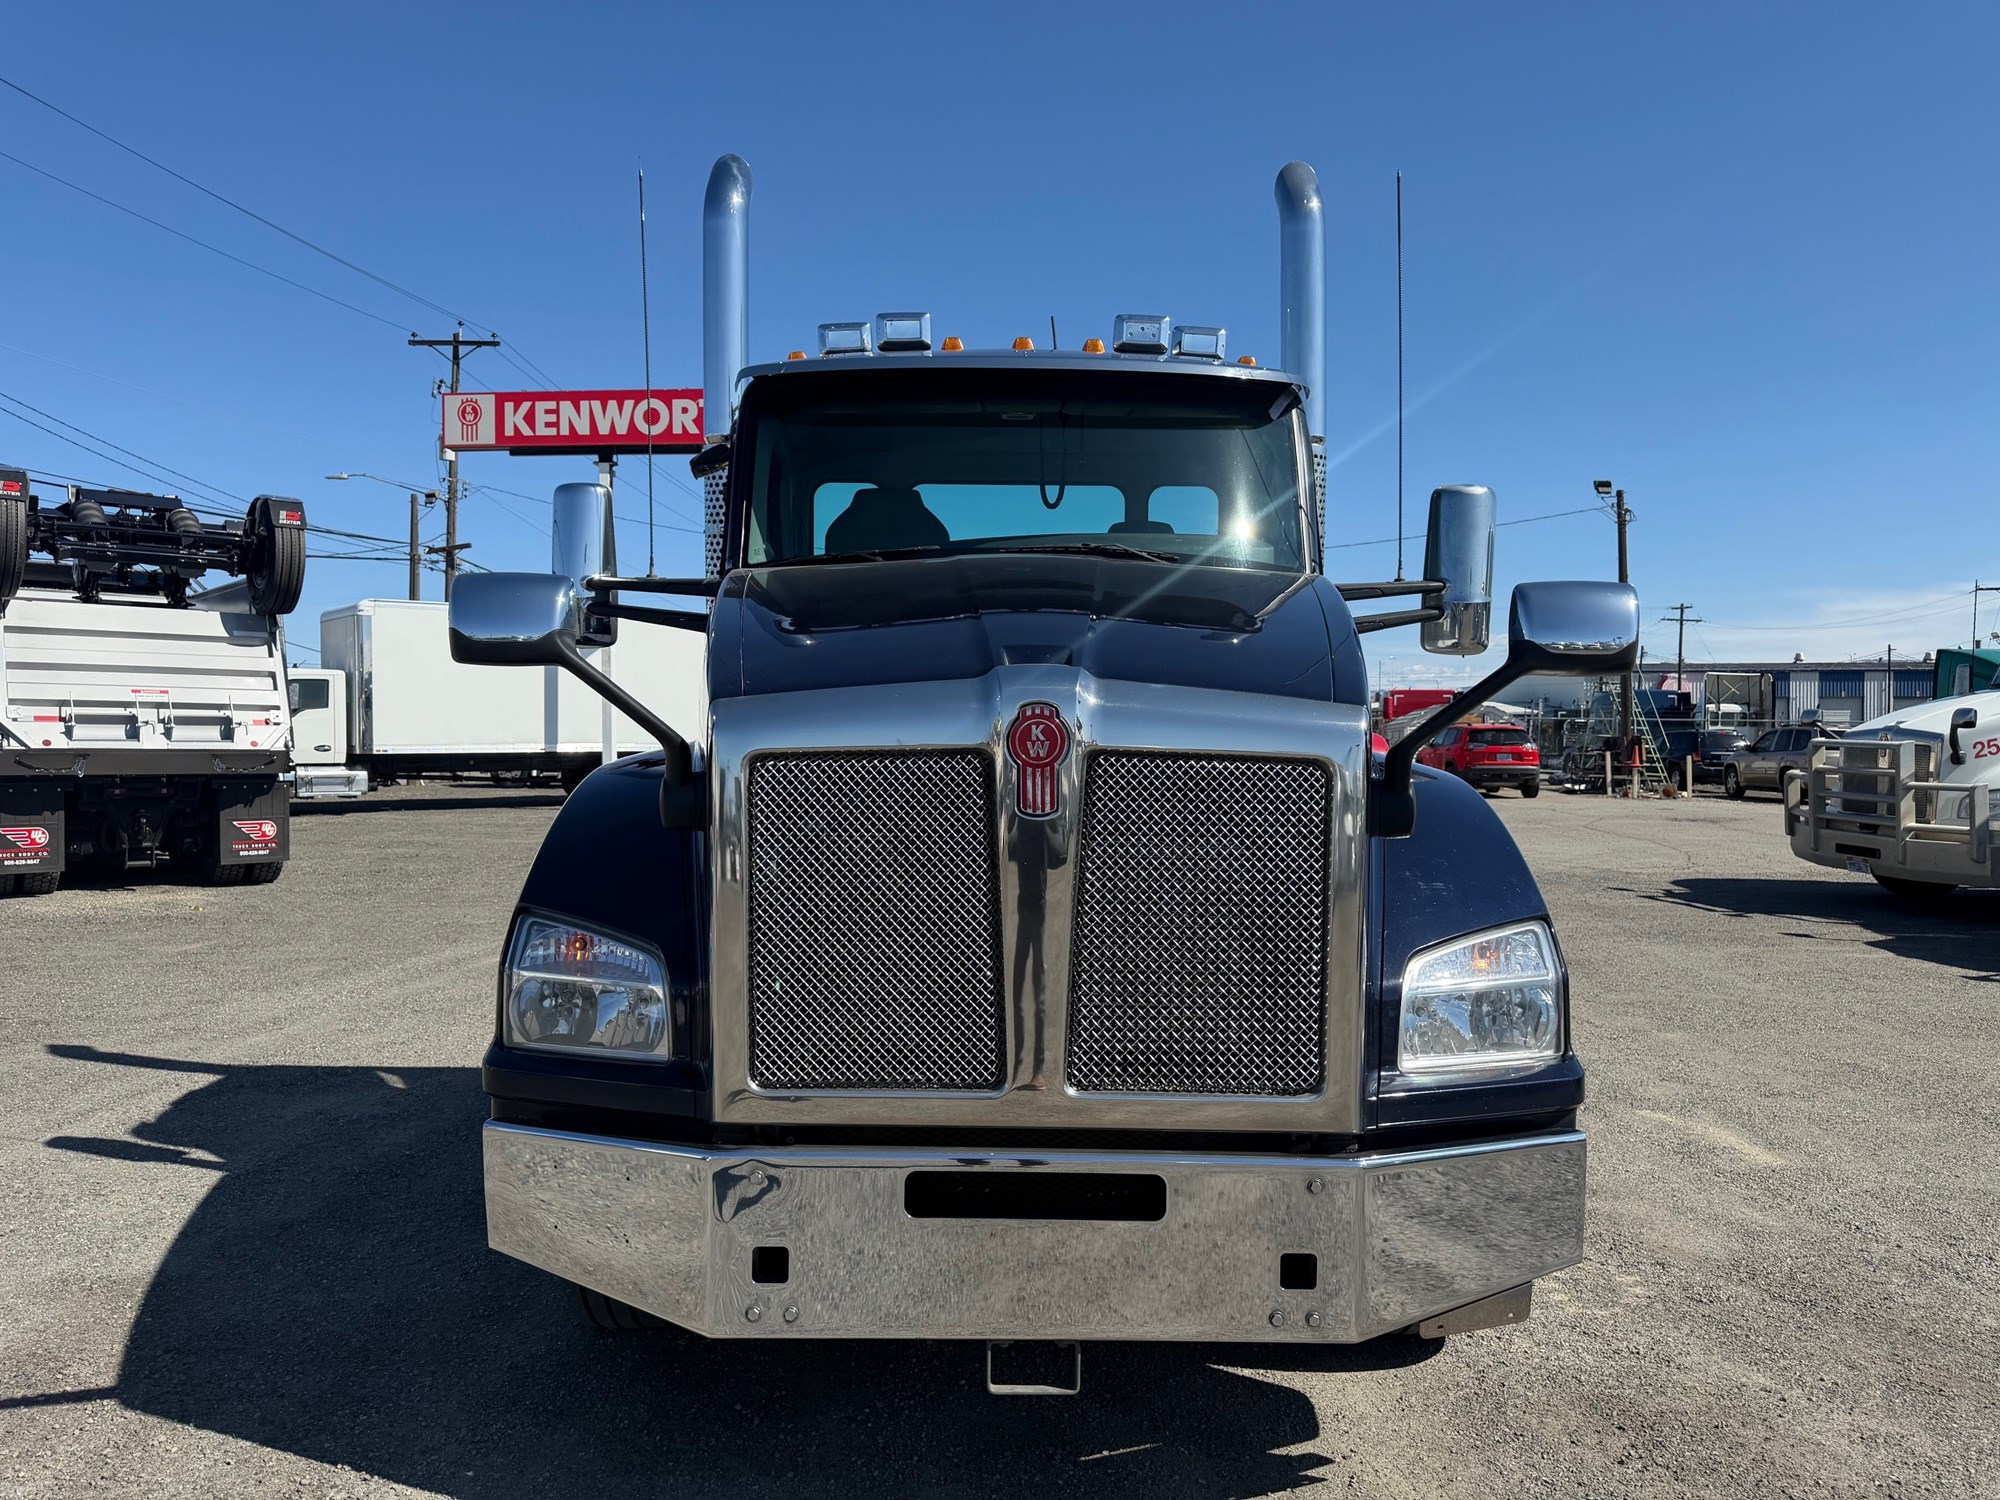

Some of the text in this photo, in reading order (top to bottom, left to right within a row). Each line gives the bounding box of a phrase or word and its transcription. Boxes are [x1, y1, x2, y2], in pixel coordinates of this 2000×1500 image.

[504, 398, 704, 437] KENWOR
[1031, 724, 1046, 741] K
[1027, 741, 1050, 758] W
